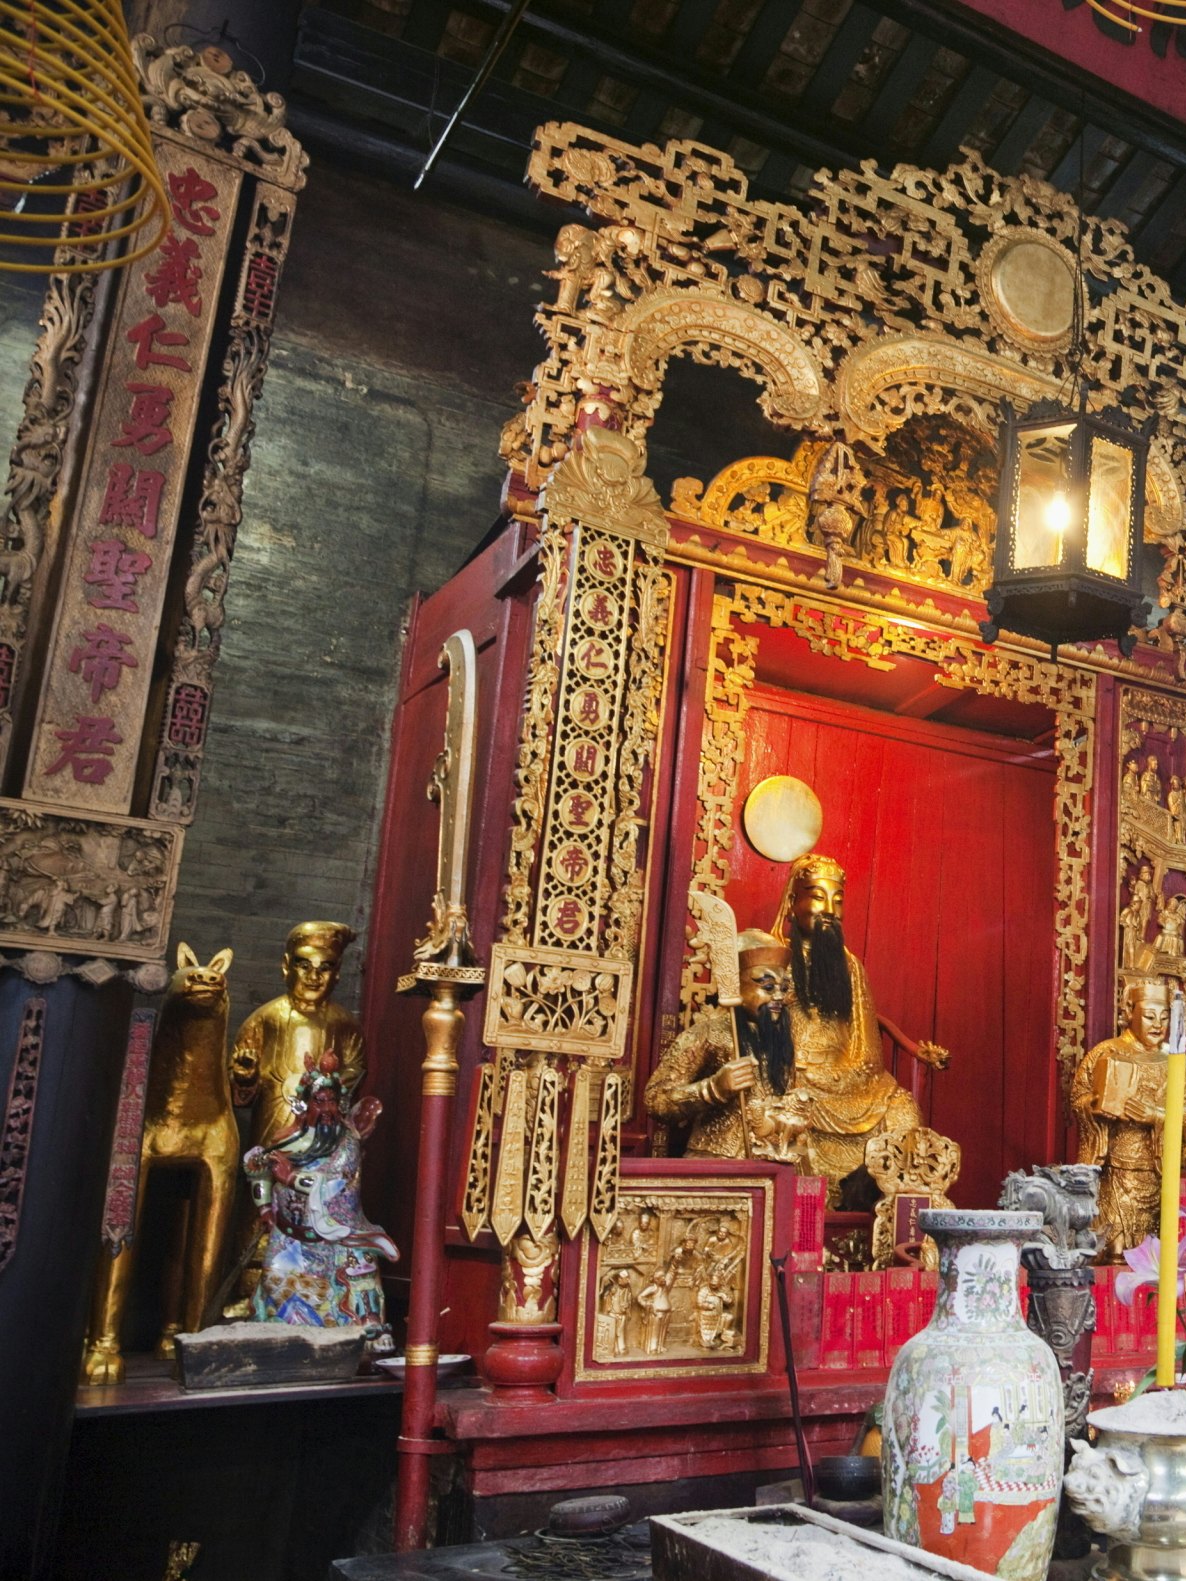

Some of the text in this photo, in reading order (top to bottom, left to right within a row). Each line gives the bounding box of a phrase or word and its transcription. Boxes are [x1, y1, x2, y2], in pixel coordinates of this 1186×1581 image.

[44, 166, 220, 785] 忠義仁勇關聖帝君
